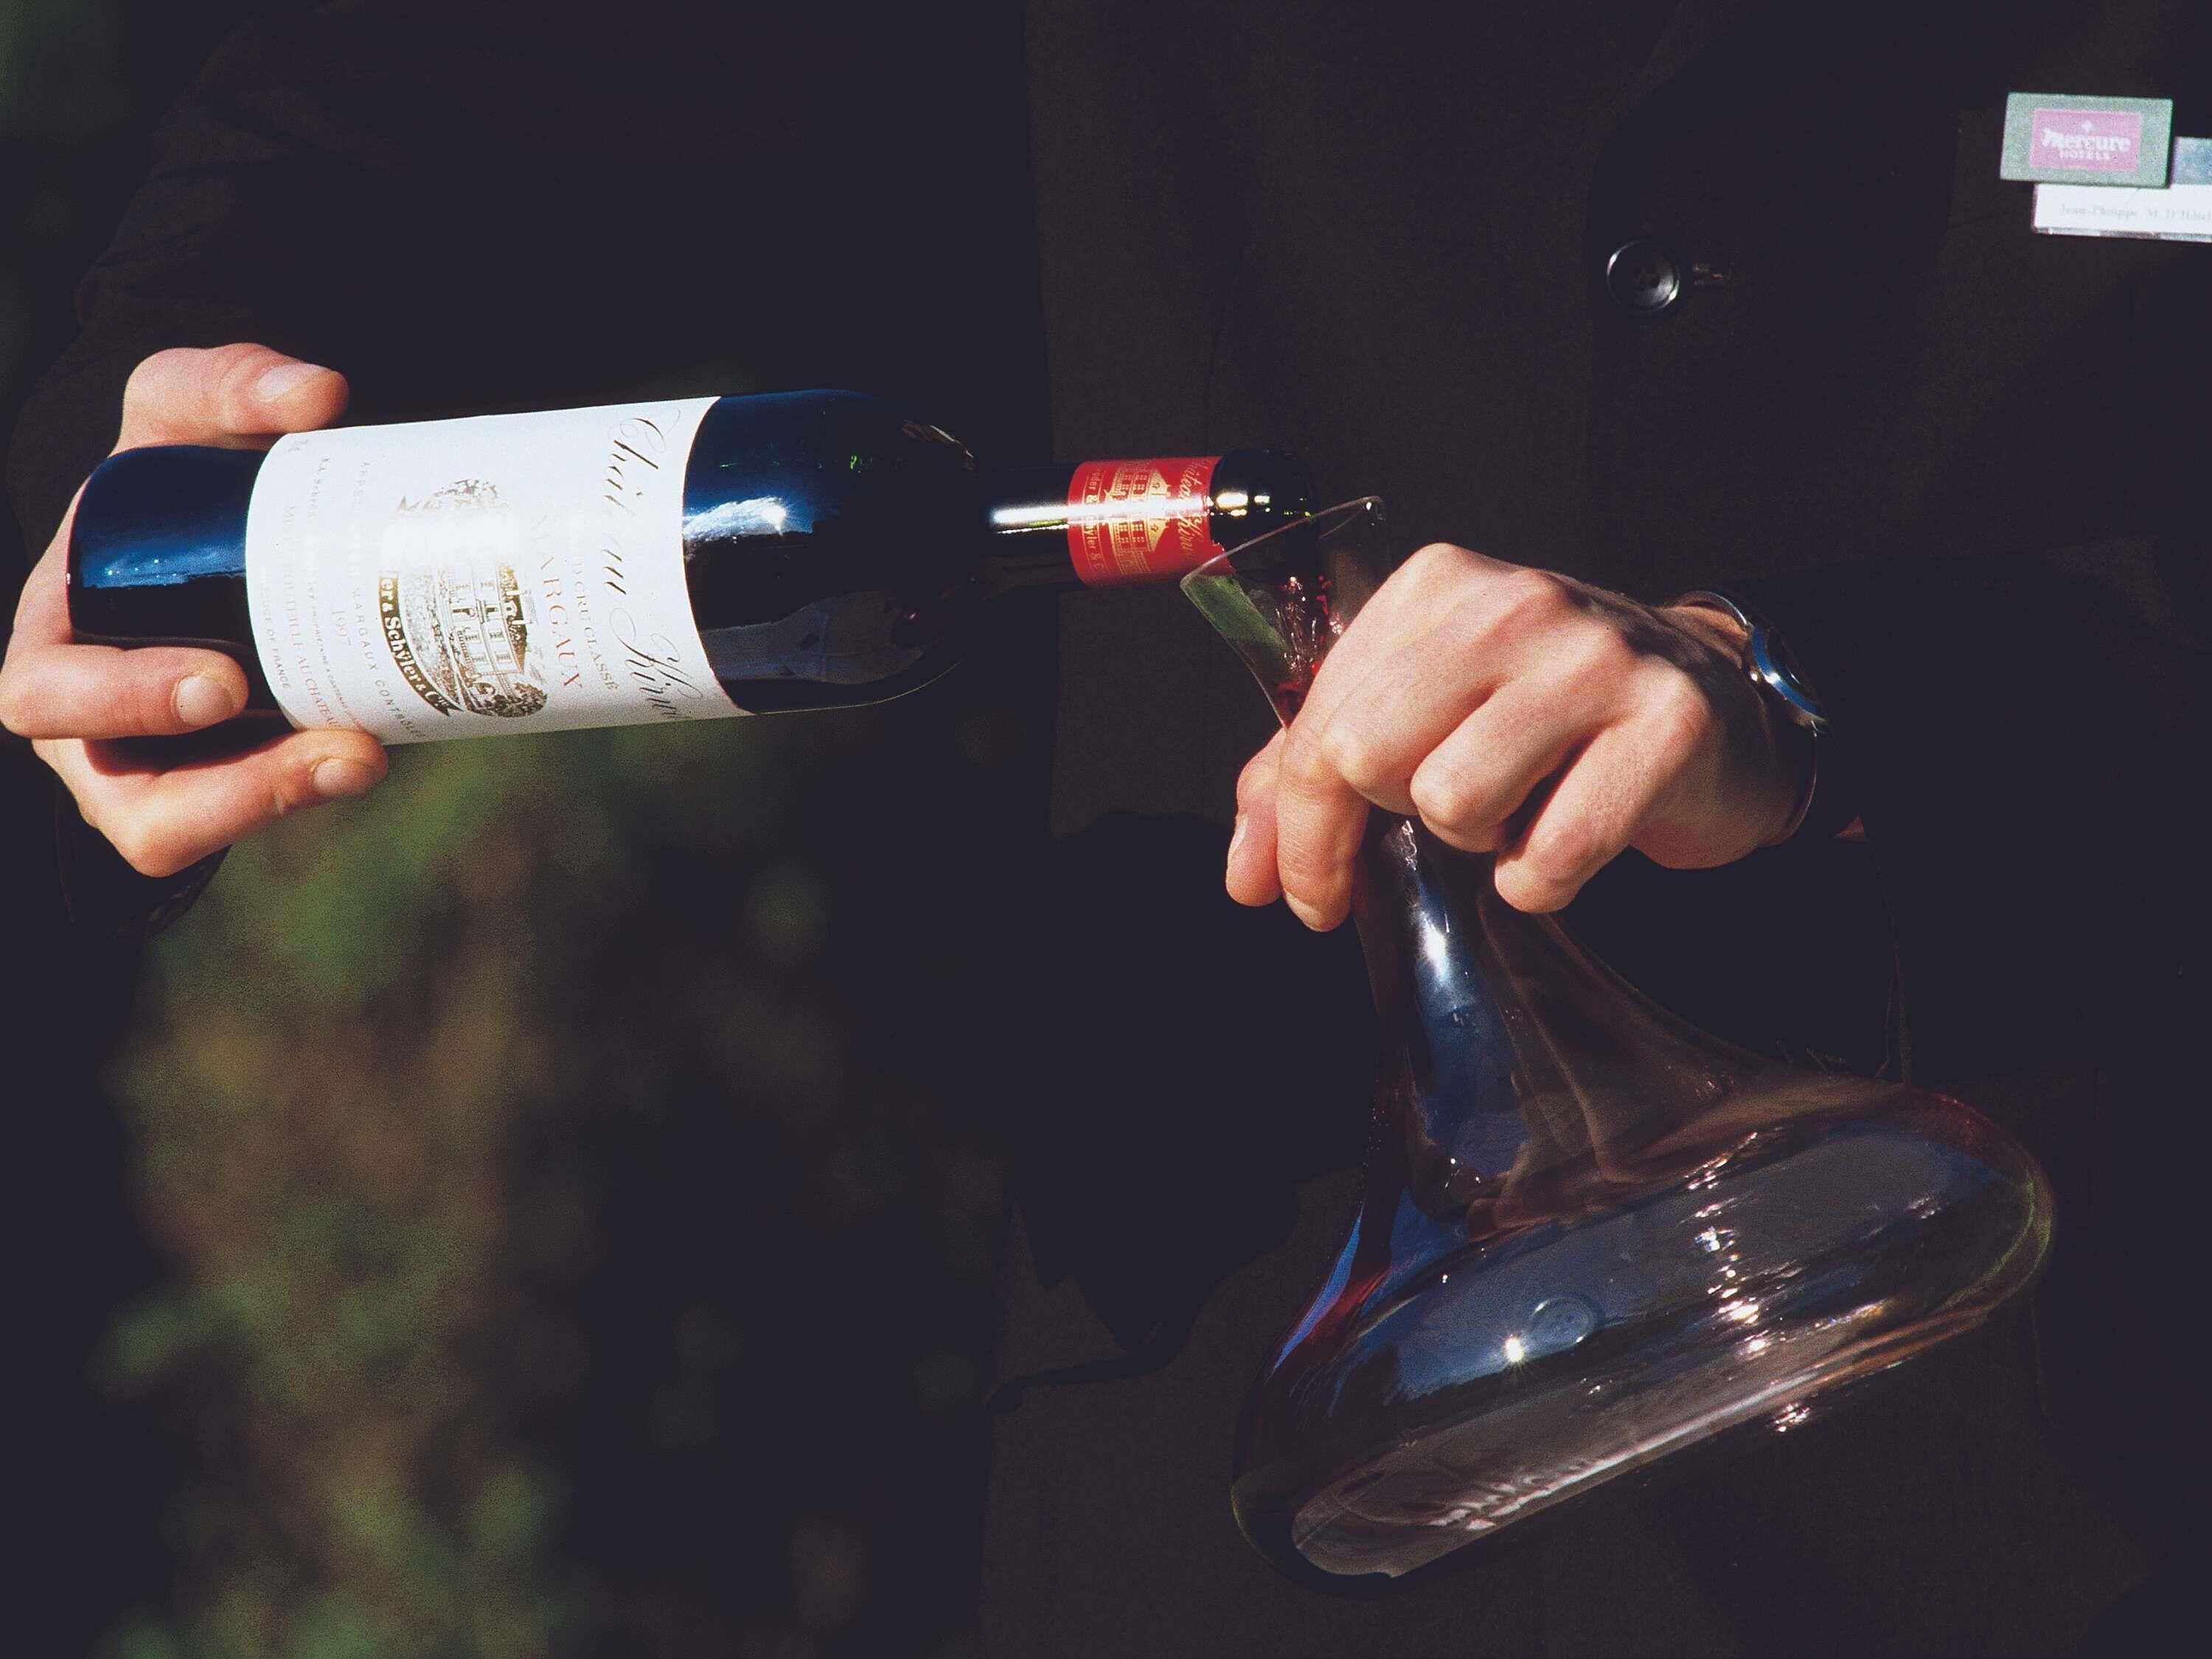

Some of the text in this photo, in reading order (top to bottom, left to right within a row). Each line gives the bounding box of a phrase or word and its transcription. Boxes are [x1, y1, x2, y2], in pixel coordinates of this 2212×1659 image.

[2059, 149, 2110, 161] HOTELS
[530, 512, 583, 690] MARGAUX
[351, 588, 377, 670] MARGAUX
[271, 648, 291, 689] FRANCE
[296, 655, 313, 675] AU
